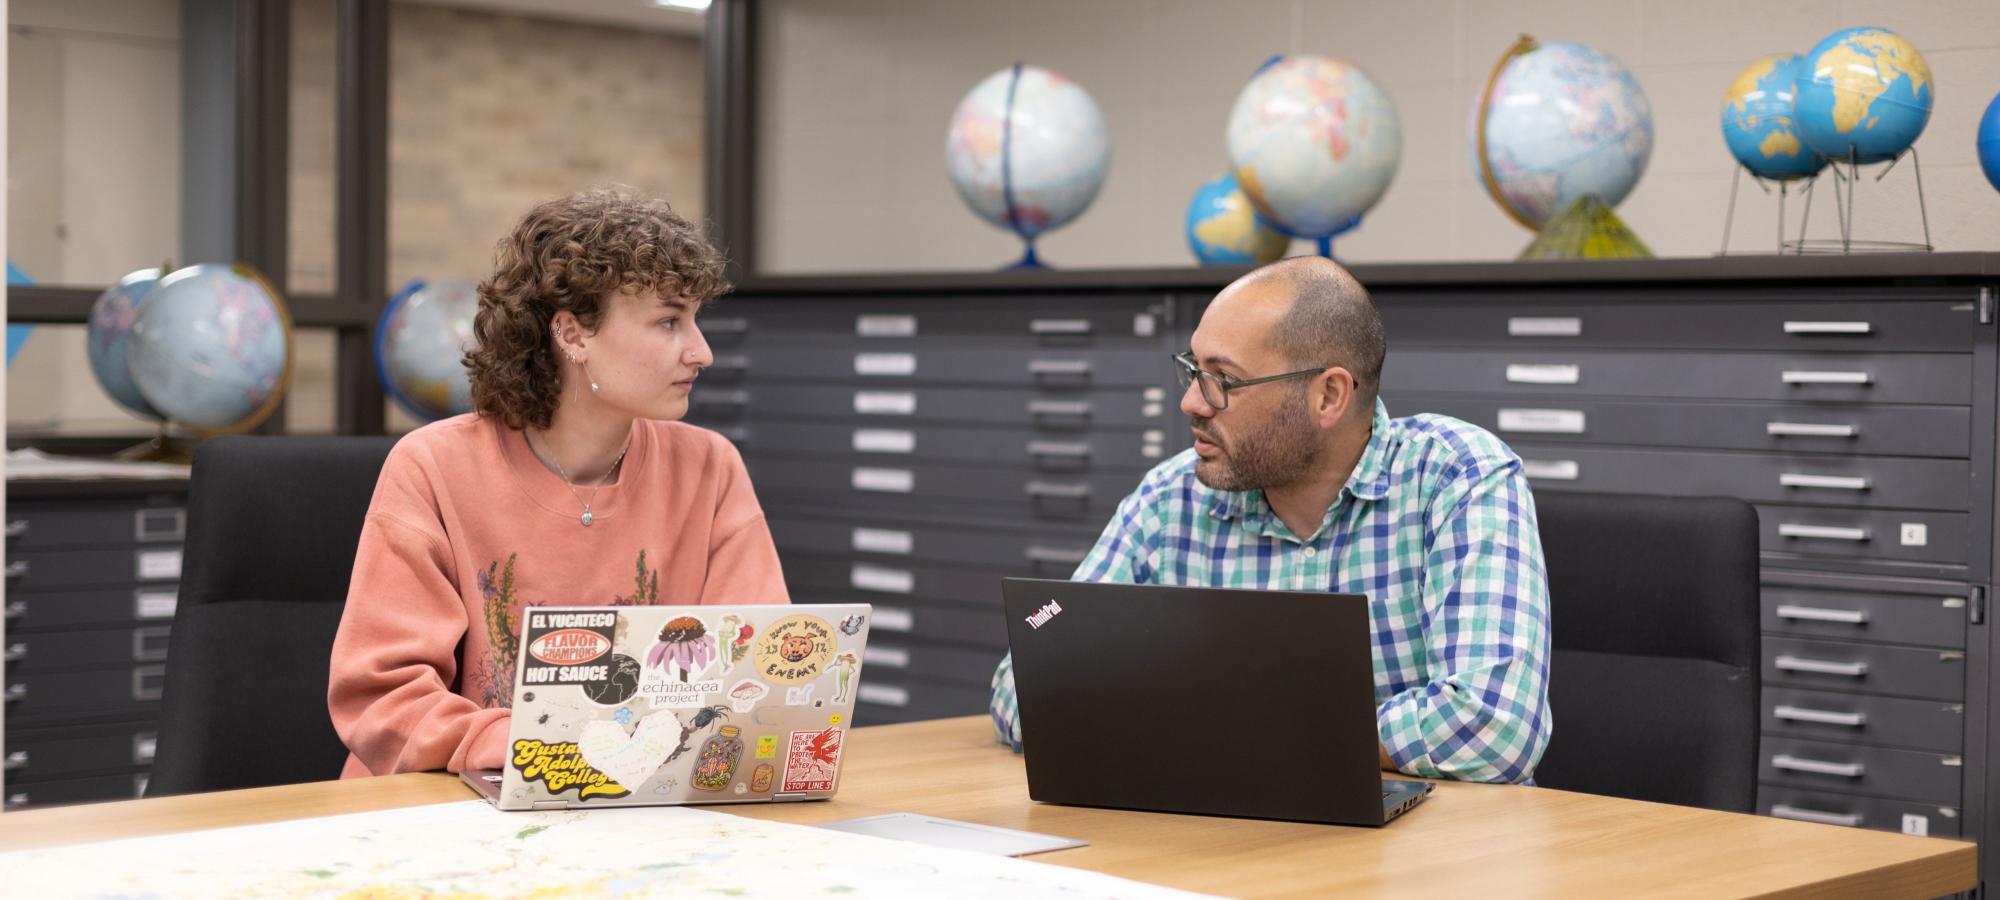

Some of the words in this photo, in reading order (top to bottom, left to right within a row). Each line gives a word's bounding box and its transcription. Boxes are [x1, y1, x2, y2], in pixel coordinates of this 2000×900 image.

[532, 614, 546, 628] EL
[548, 613, 616, 628] YUCATECO
[1025, 599, 1062, 630] ThinkPad
[804, 621, 828, 638] YOUR
[544, 634, 598, 647] FLAVOR
[543, 647, 597, 660] CHAMPIONS
[526, 667, 557, 682] HOT
[559, 666, 608, 681] SAUCE
[766, 663, 817, 679] ENEMY
[642, 680, 719, 693] echinacea
[655, 694, 699, 705] project
[523, 755, 590, 777] Adolp
[785, 782, 806, 790] STOP
[808, 782, 825, 790] LINE
[825, 781, 832, 790] 3
